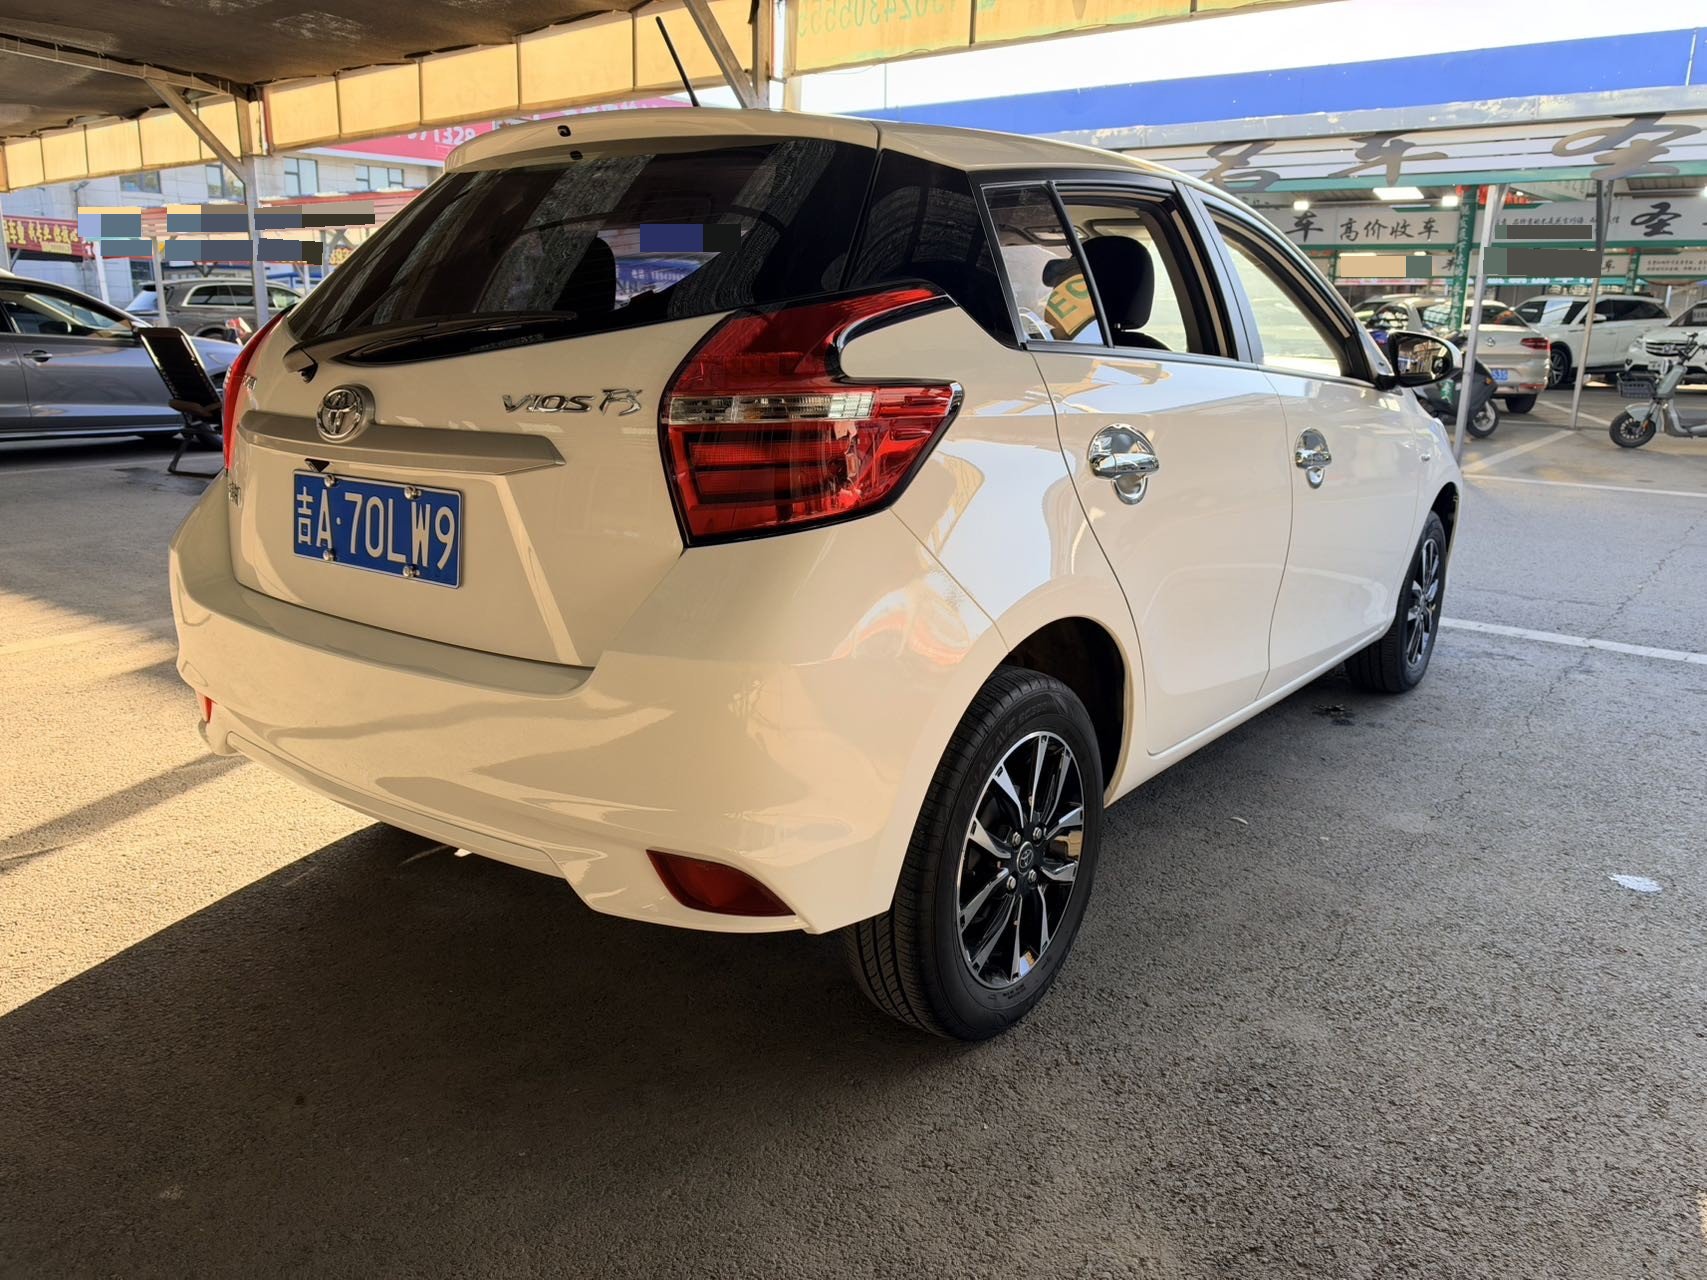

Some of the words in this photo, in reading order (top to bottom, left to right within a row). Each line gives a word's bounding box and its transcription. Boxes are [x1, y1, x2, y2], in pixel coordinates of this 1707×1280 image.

[1285, 210, 1324, 242] 车
[1340, 217, 1439, 242] 高价收车
[1631, 202, 1707, 237] 圣
[502, 394, 597, 413] VIOS
